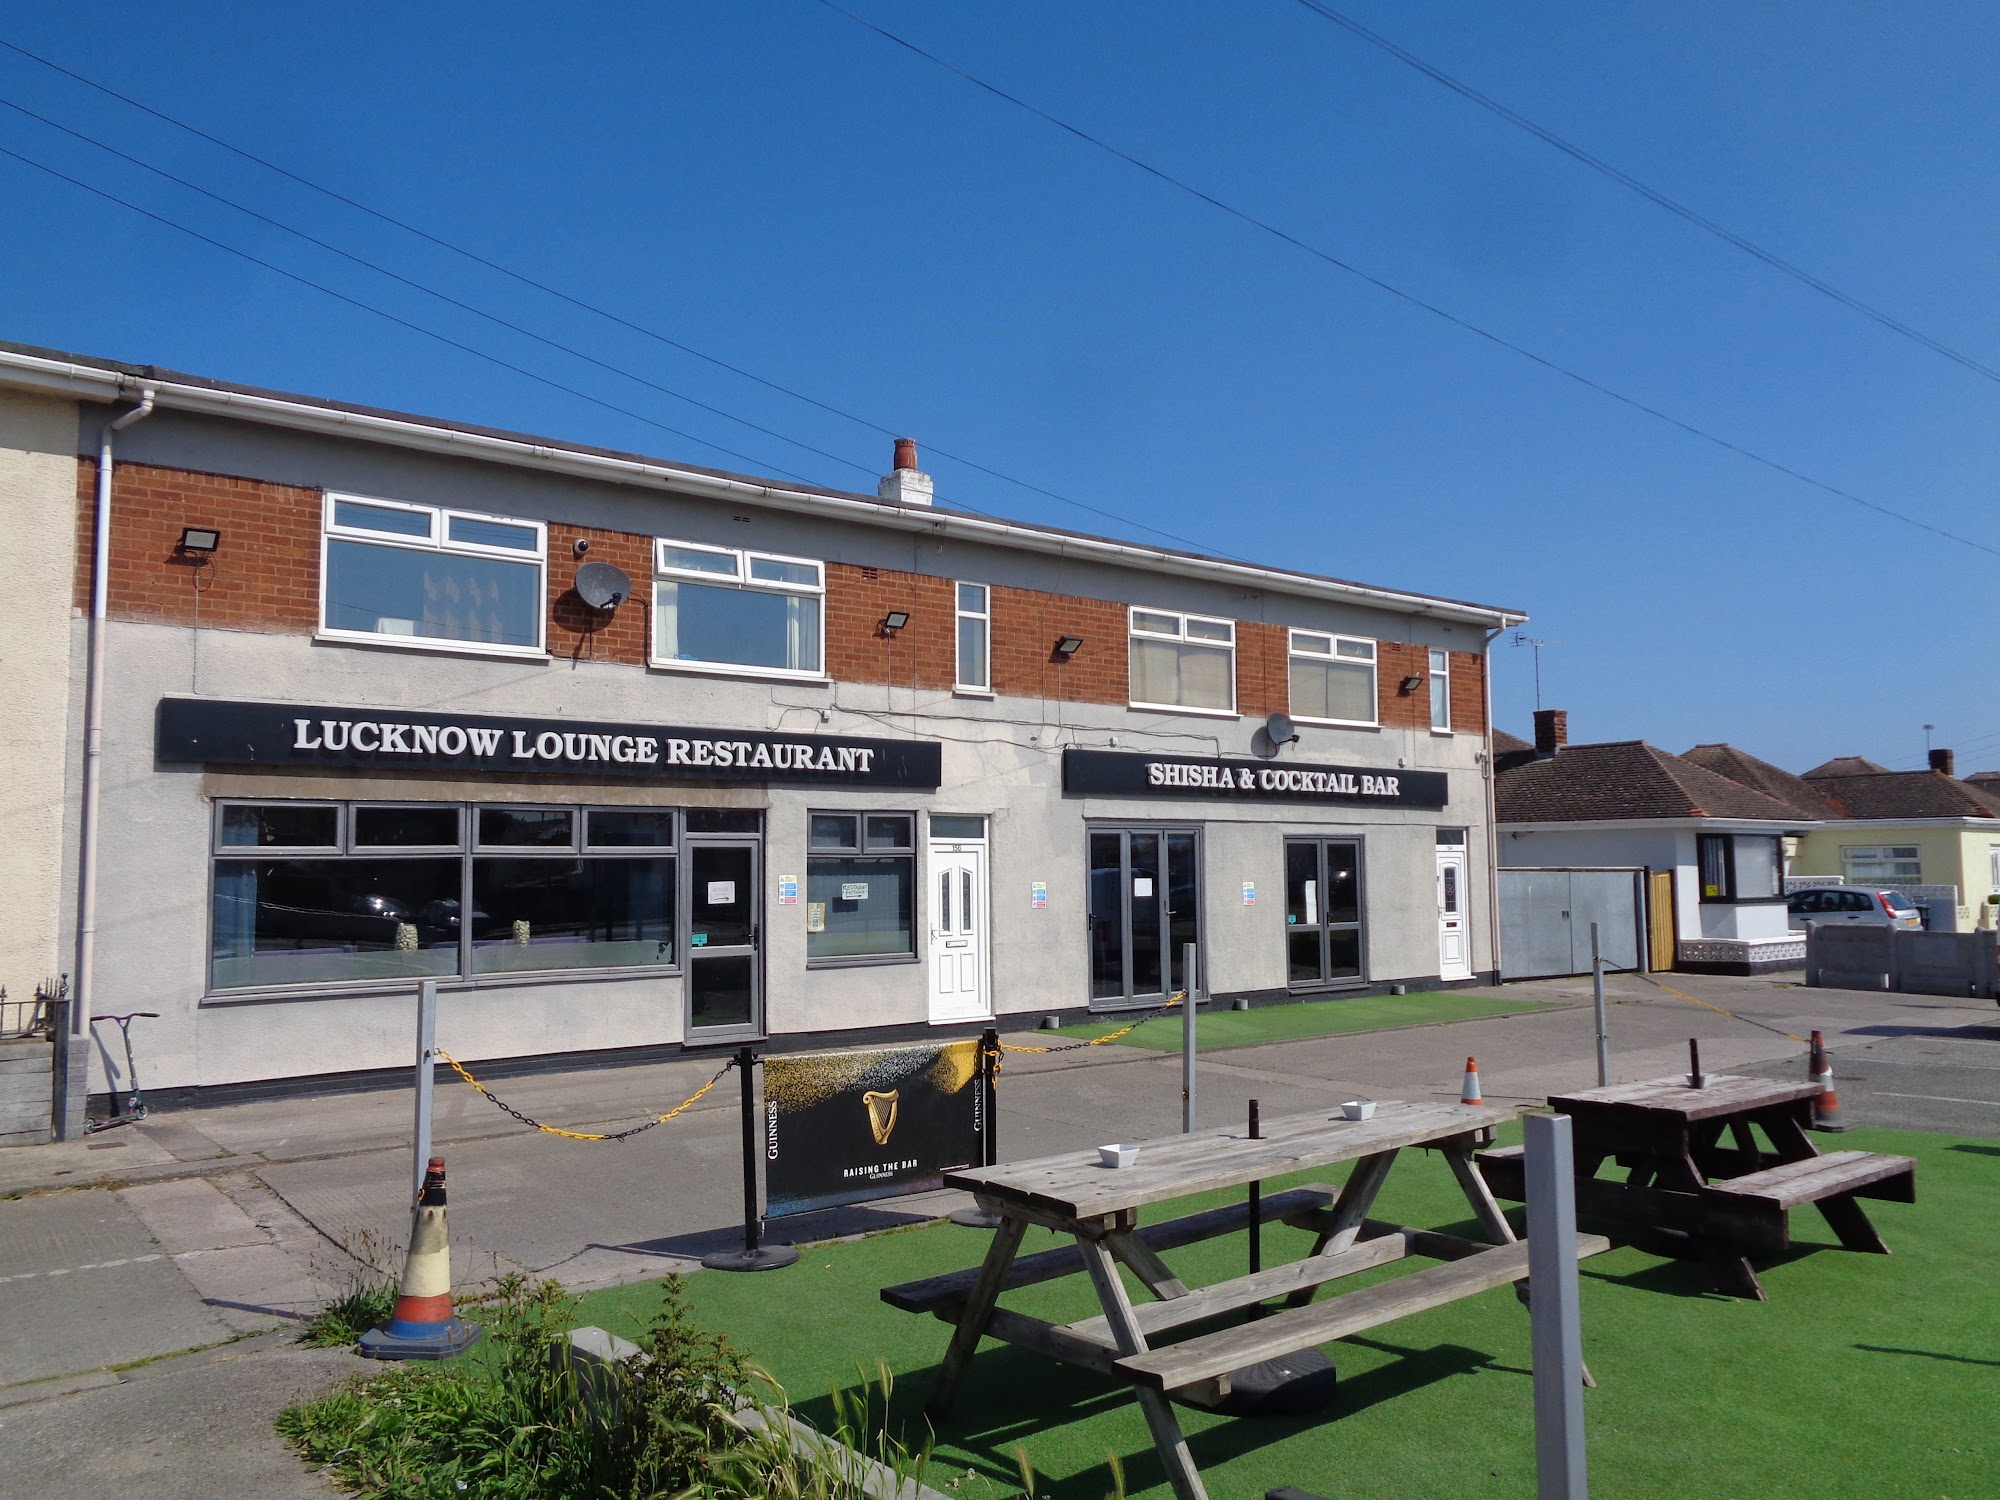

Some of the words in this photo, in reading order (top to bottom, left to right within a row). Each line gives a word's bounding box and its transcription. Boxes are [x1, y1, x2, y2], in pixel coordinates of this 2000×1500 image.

[293, 718, 504, 757] LUCKNOW
[510, 730, 659, 765] LOUNGE
[666, 738, 875, 773] RESTAURANT
[1148, 762, 1236, 789] SHISHA
[1238, 767, 1256, 790] &
[1259, 769, 1359, 794] COCKTAIL
[1361, 775, 1401, 796] BAR
[973, 1078, 982, 1132] GUINNESS
[767, 1100, 779, 1160] GUINNESS
[843, 1164, 880, 1178] RAISING
[882, 1161, 899, 1172] THE
[901, 1159, 918, 1169] BAR
[869, 1171, 894, 1180] GUINNESS
